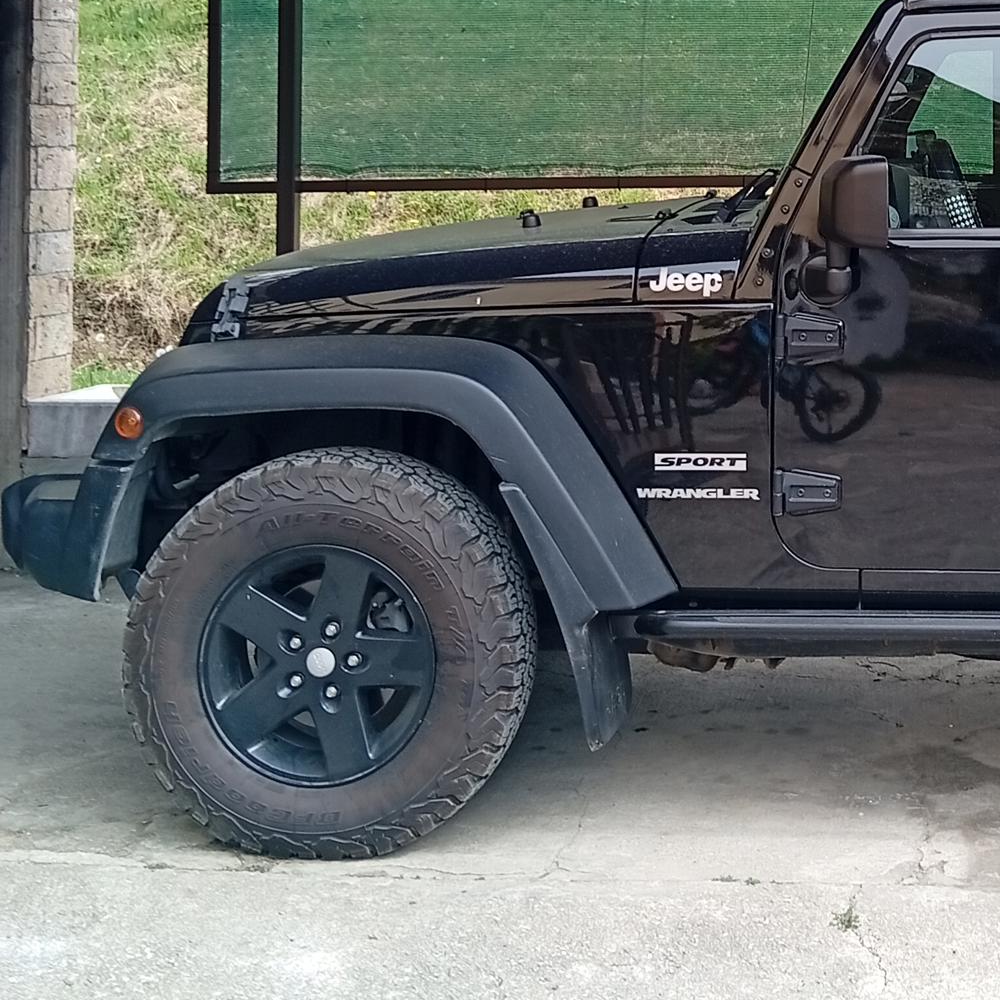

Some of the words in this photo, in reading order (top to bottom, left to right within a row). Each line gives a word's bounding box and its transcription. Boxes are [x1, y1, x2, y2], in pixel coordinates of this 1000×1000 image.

[650, 267, 722, 297] Jeep
[655, 456, 746, 468] SPORT
[637, 488, 760, 500] WRANGLER
[257, 510, 445, 591] All-Terrain
